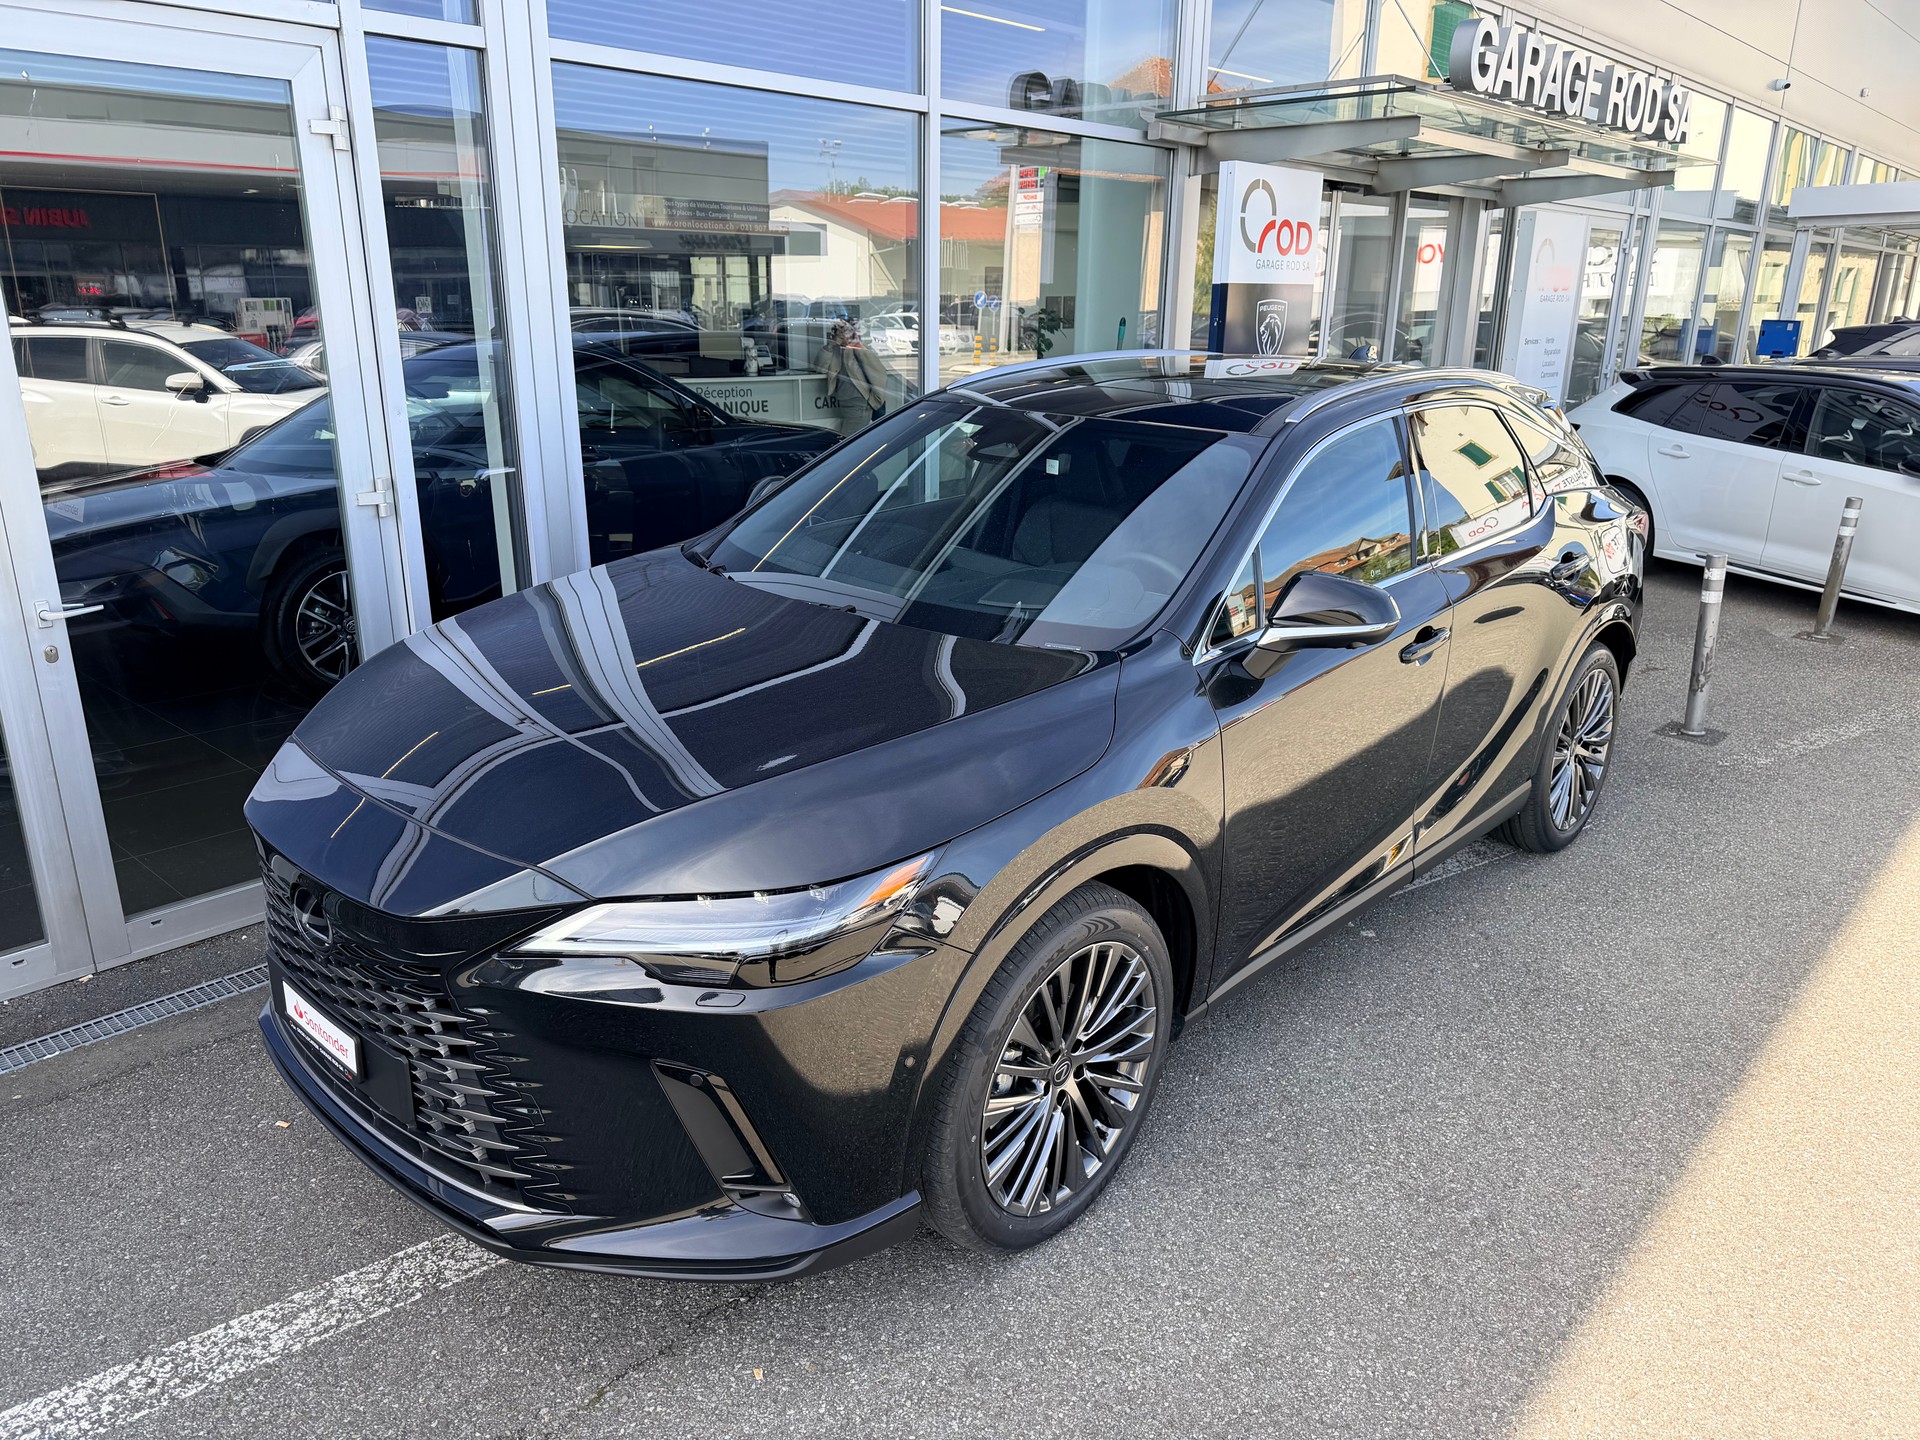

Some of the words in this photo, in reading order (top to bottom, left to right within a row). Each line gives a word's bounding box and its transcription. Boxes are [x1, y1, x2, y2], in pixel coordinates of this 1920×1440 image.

[1471, 17, 1606, 121] GARAGE
[1605, 65, 1665, 135] ROD
[1663, 85, 1692, 143] SA
[1255, 259, 1284, 270] GARAGE
[1286, 260, 1301, 271] ROD
[1302, 261, 1310, 271] SA
[1259, 304, 1285, 312] PEUGEOT
[696, 386, 753, 400] Réception
[303, 1010, 349, 1059] Santander
